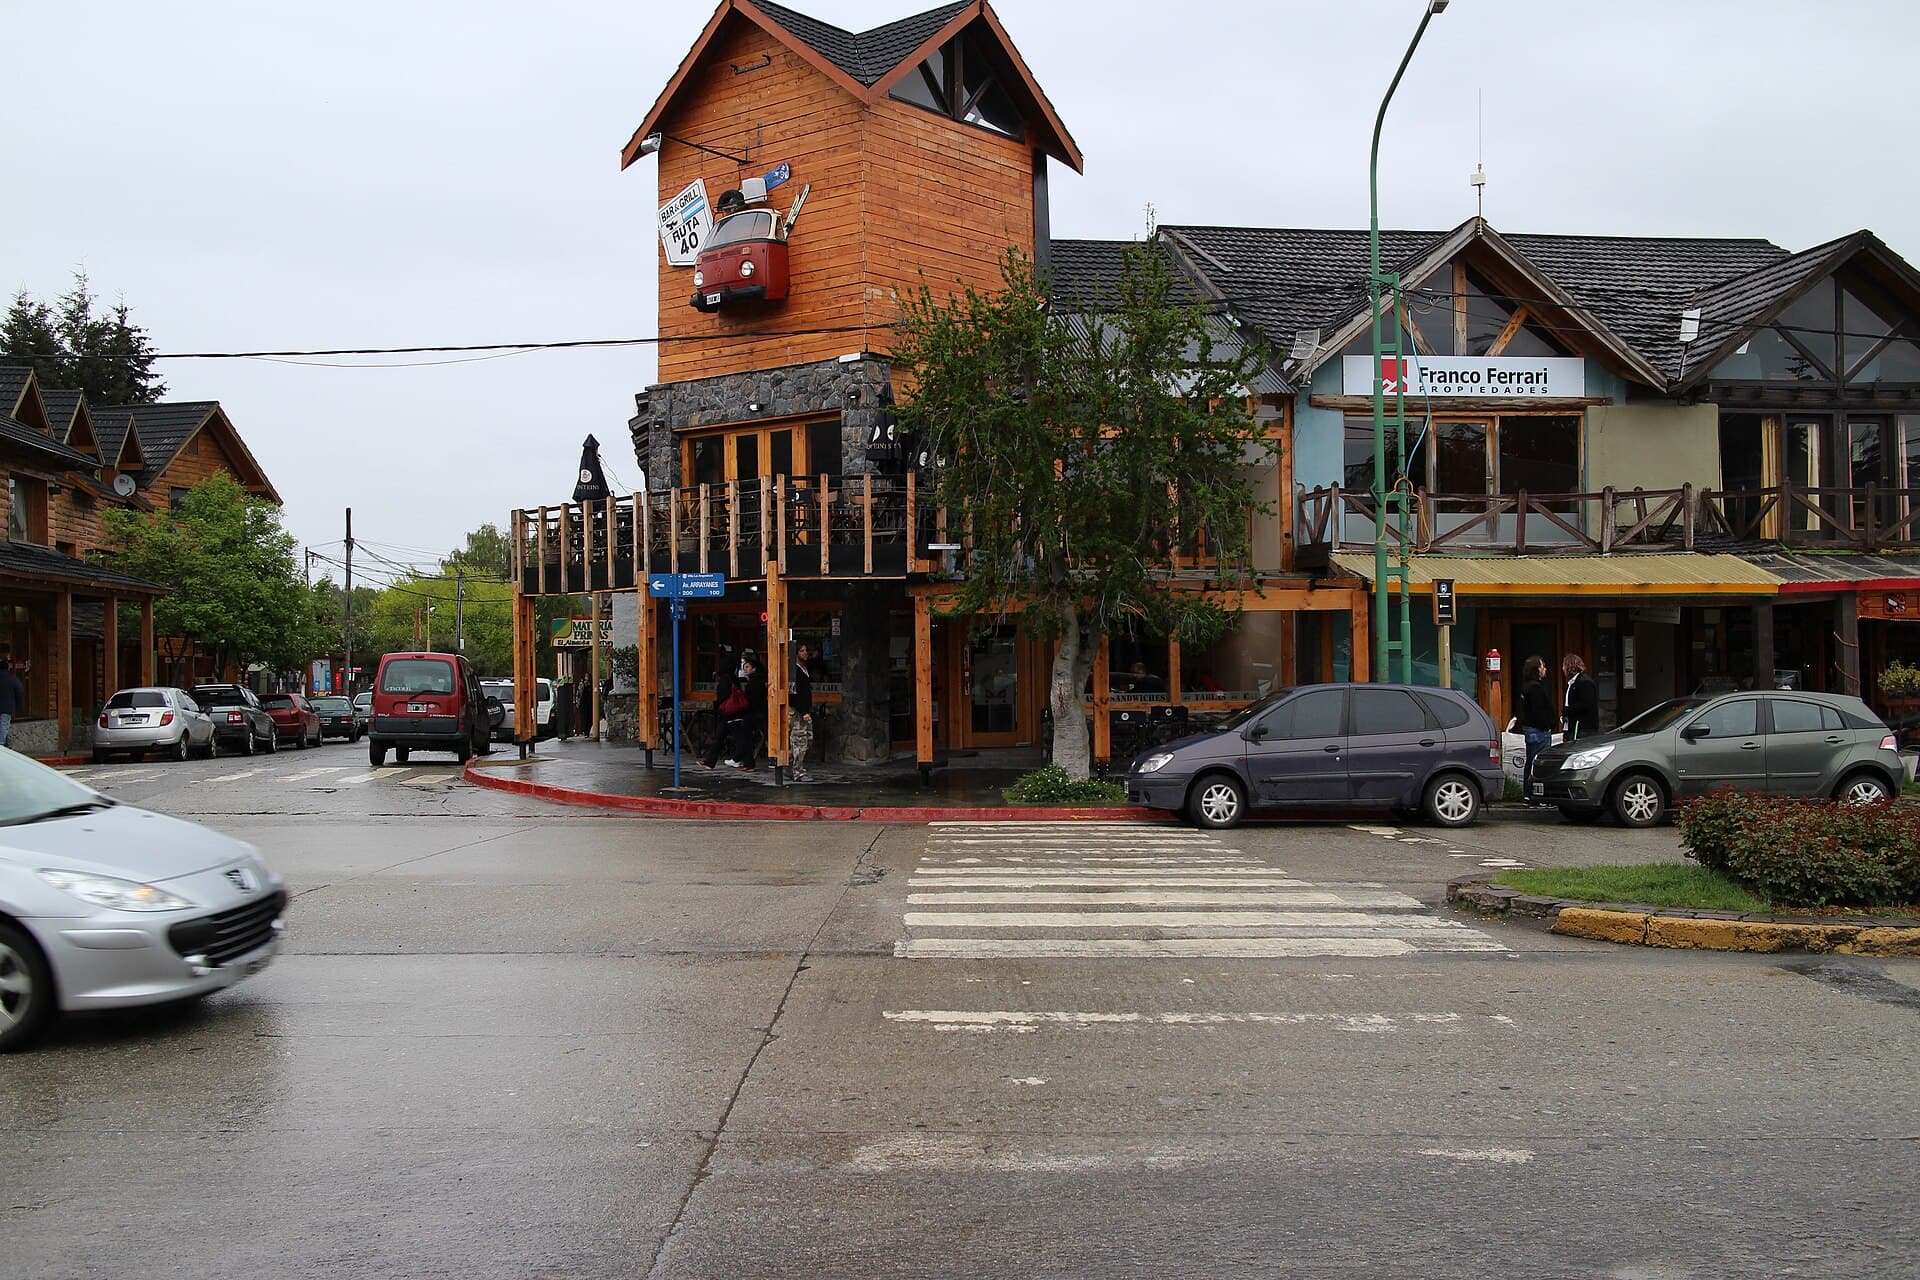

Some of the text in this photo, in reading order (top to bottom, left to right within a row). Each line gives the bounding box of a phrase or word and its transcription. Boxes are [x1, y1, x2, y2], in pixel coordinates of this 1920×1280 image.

[661, 190, 699, 222] BAR & GRILL
[672, 216, 700, 243] RUTA
[680, 231, 699, 255] 40
[1419, 367, 1548, 384] Franco Ferrari
[1109, 694, 1166, 704] SANDWICHES
